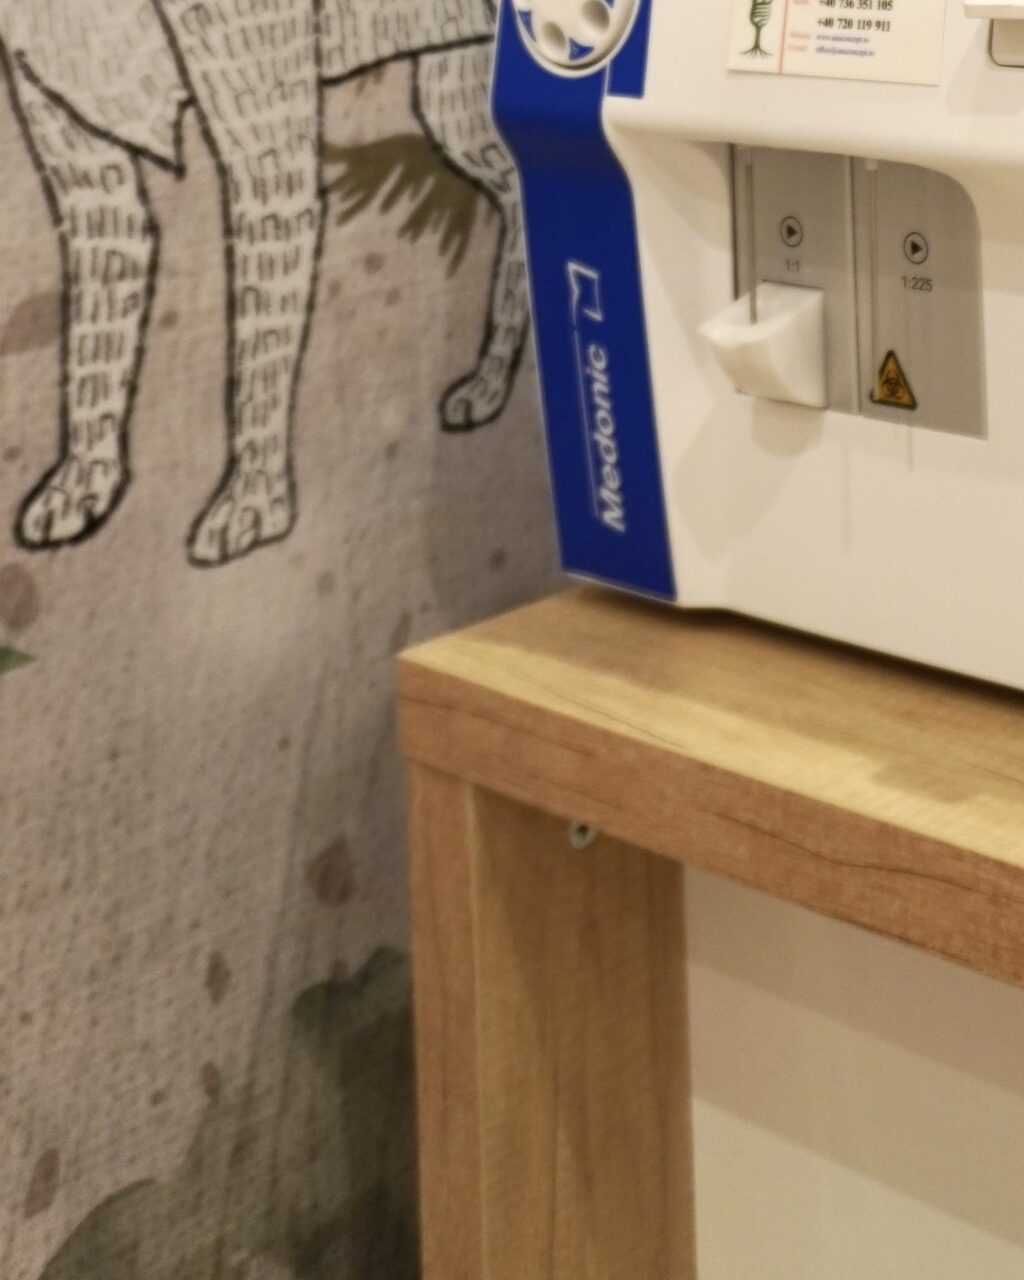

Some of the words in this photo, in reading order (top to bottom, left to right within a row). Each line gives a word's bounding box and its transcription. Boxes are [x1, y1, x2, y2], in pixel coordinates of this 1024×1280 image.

[877, 0, 893, 11] 105
[817, 18, 834, 28] +40
[857, 19, 872, 31] 119
[875, 20, 891, 32] 911
[901, 275, 933, 293] 1:225
[588, 342, 626, 533] Medonic
